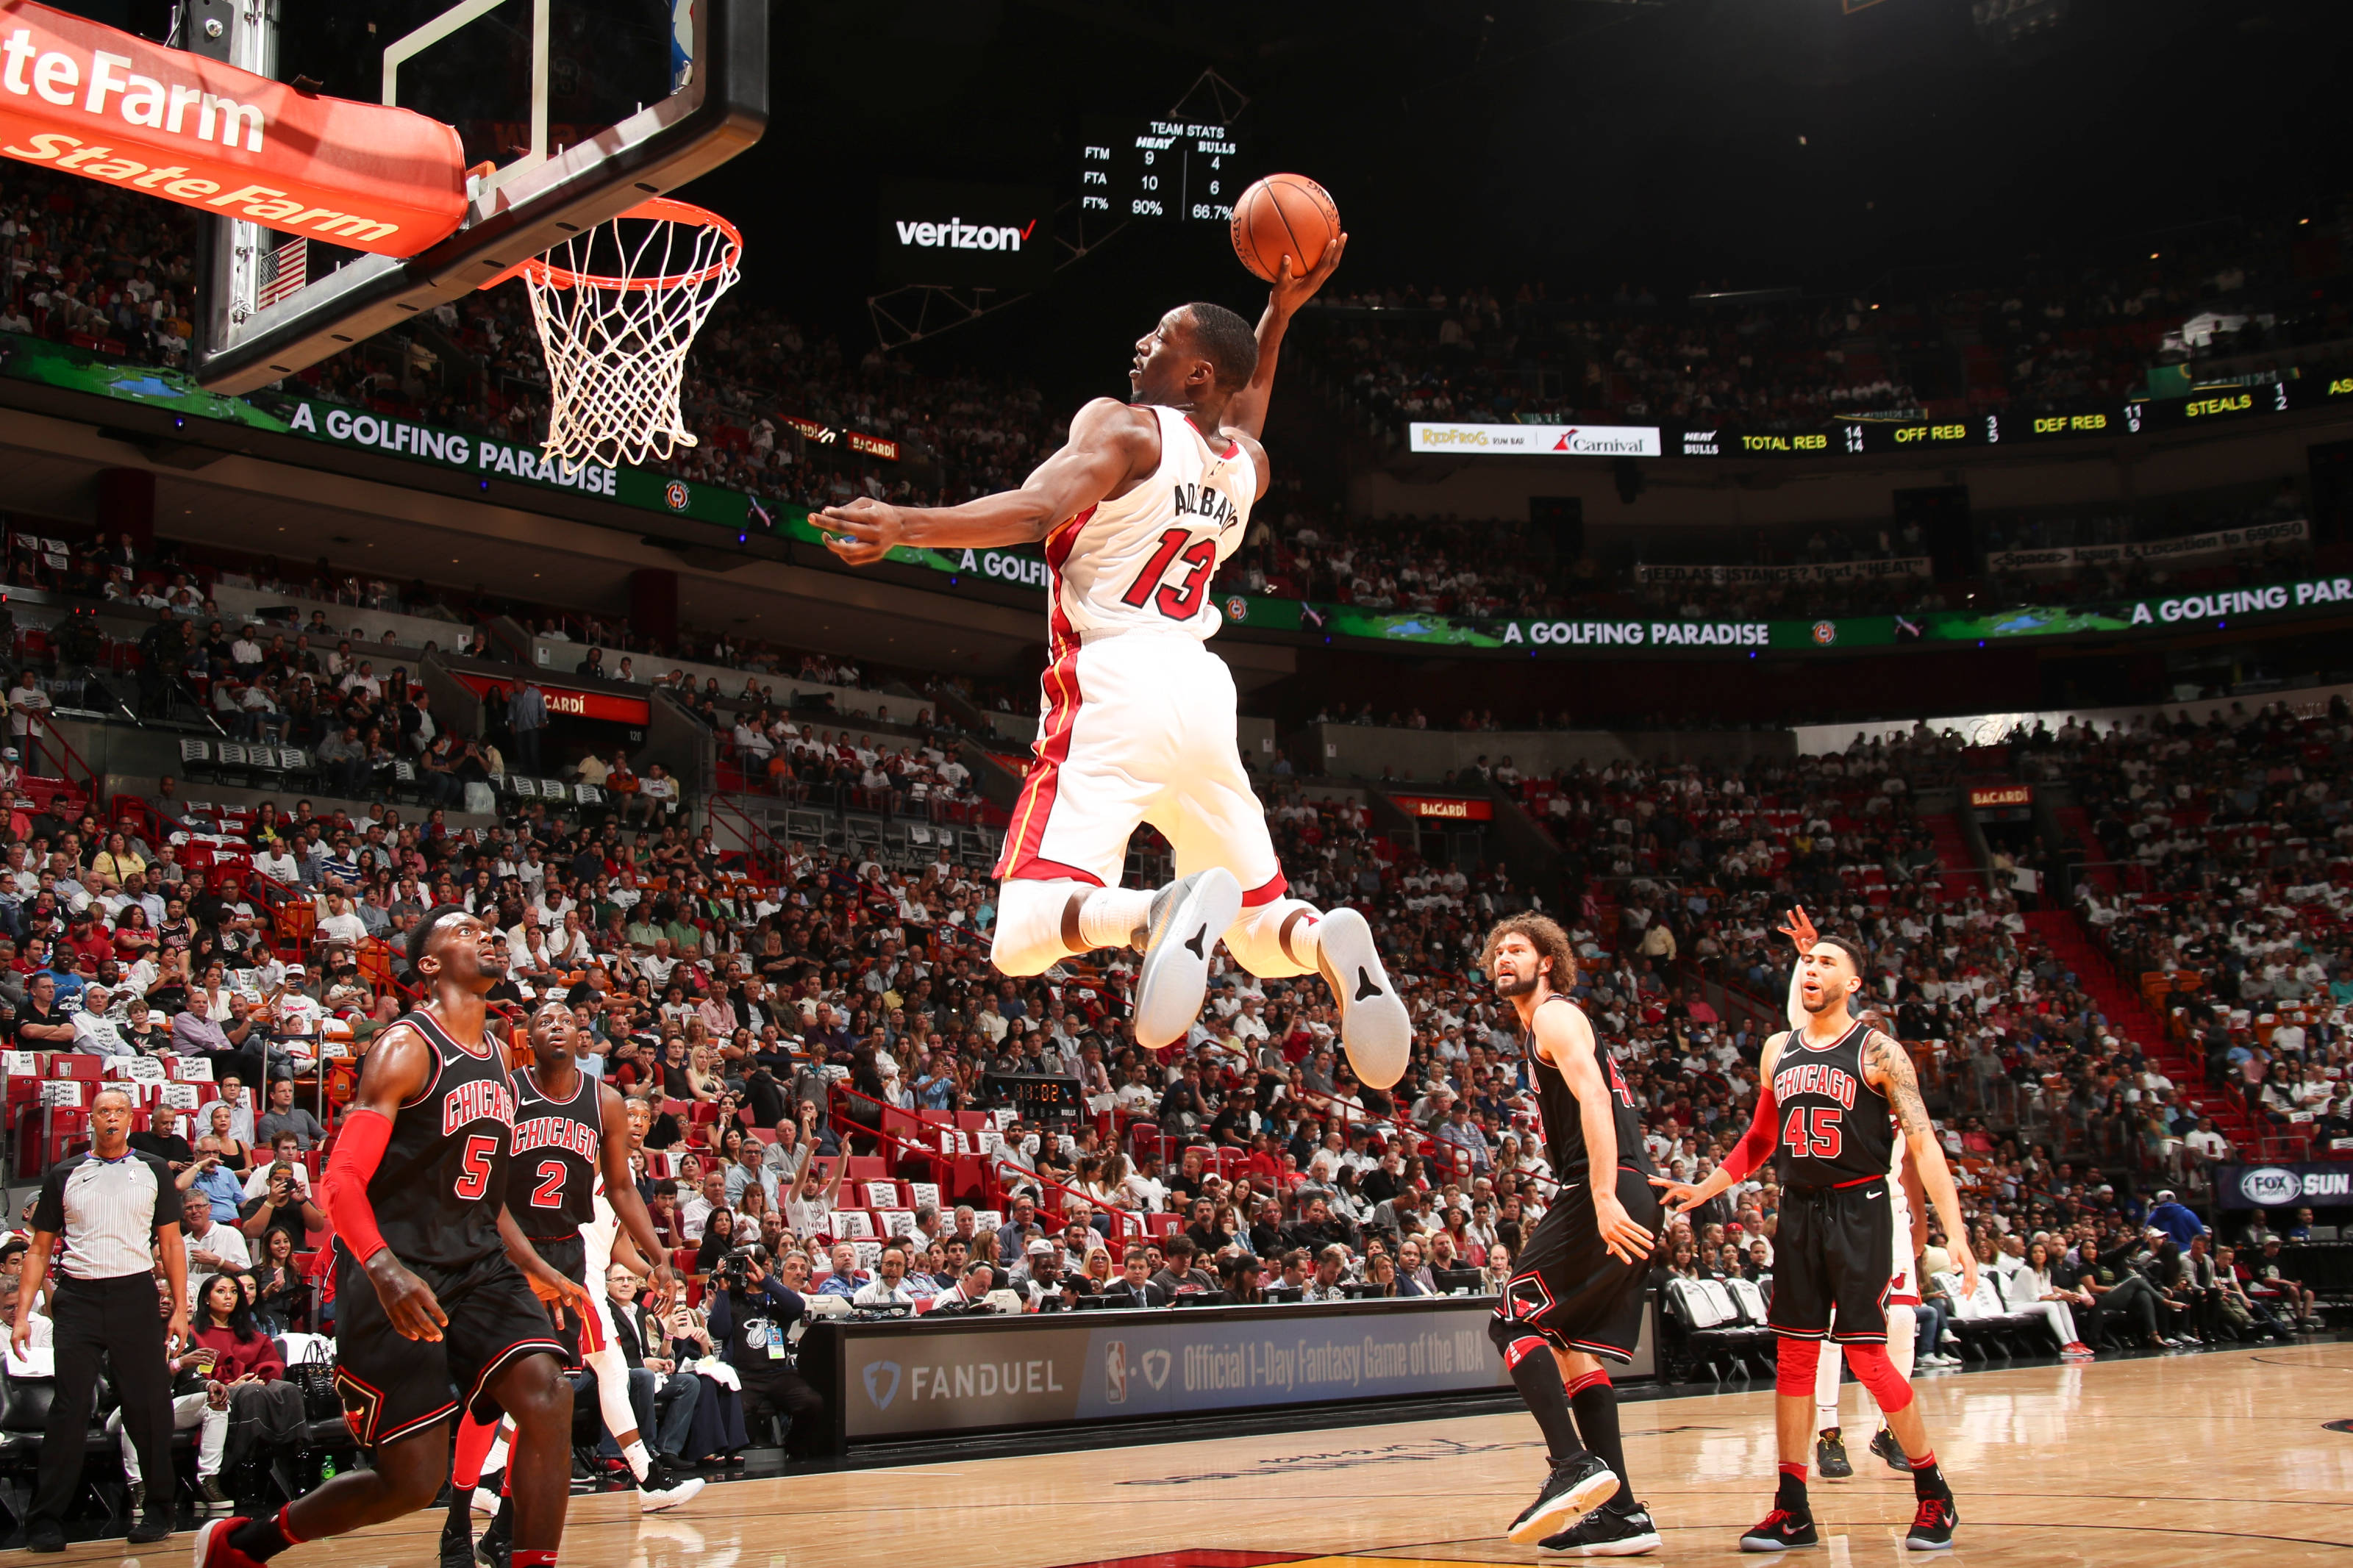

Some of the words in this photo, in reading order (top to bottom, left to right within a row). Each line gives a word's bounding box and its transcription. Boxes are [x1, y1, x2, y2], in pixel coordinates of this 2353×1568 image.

[1150, 121, 1183, 136] TEAM
[1187, 124, 1224, 139] STATS
[1135, 136, 1176, 149] HEAT
[1198, 140, 1236, 154] BULLS
[1085, 146, 1110, 160] FTM
[1145, 151, 1154, 165] 9
[1211, 156, 1220, 170] 4
[1084, 171, 1107, 185] FTA
[1141, 176, 1158, 190] 10
[1210, 180, 1220, 195] 6
[1082, 196, 1108, 210] FT%
[1132, 199, 1163, 215] 90%
[1193, 204, 1234, 221] 66.7%
[896, 217, 1021, 251] verizon
[2274, 382, 2284, 395] 1
[2124, 404, 2141, 419] 11
[2186, 395, 2252, 417] STEALS
[2275, 395, 2288, 411] 2
[1987, 415, 1997, 429] 3
[2034, 417, 2067, 433] DEF
[2071, 414, 2107, 430] REB
[2129, 419, 2140, 433] 9
[1684, 431, 1718, 441] HEAT
[1844, 425, 1863, 439] 14
[1895, 426, 1928, 443] OFF
[1932, 424, 1965, 440] REB
[1988, 429, 1999, 443] 5
[290, 402, 316, 433] A
[326, 410, 470, 465] GOLFING
[479, 442, 616, 496] PARADISE
[1574, 438, 1644, 454] Carnival
[1684, 444, 1718, 455] BULLS
[1743, 436, 1790, 451] TOTAL
[1793, 434, 1827, 450] REB
[1846, 440, 1864, 453] 14
[960, 548, 977, 572] A
[984, 552, 1049, 587] GOLFI
[1121, 528, 1216, 622] 13
[2132, 603, 2154, 624] A
[2160, 587, 2288, 622] GOLFING
[1504, 623, 1524, 643] A
[1530, 623, 1644, 644] GOLFING
[1652, 623, 1769, 645] PARADISE
[543, 694, 585, 714] CARDÍ
[1972, 787, 2029, 805] BACARDÍ
[1421, 801, 1467, 817] BACARDÍ
[1775, 1064, 1857, 1111] CHICAGO
[510, 1117, 598, 1164] CHICAGO
[1783, 1106, 1842, 1159] 45
[454, 1134, 499, 1200] 5
[530, 1160, 568, 1209] 2
[2254, 1176, 2285, 1190] FOX
[2303, 1174, 2349, 1196] SUN
[1184, 1342, 1246, 1392] Official
[1248, 1340, 1296, 1392] 1-Day
[1298, 1339, 1360, 1388] Fantasy
[1364, 1335, 1407, 1379] Game
[1410, 1333, 1427, 1375] of
[1427, 1332, 1452, 1375] the
[1455, 1330, 1485, 1372] NBA
[912, 1360, 1063, 1402] FANDUEL
